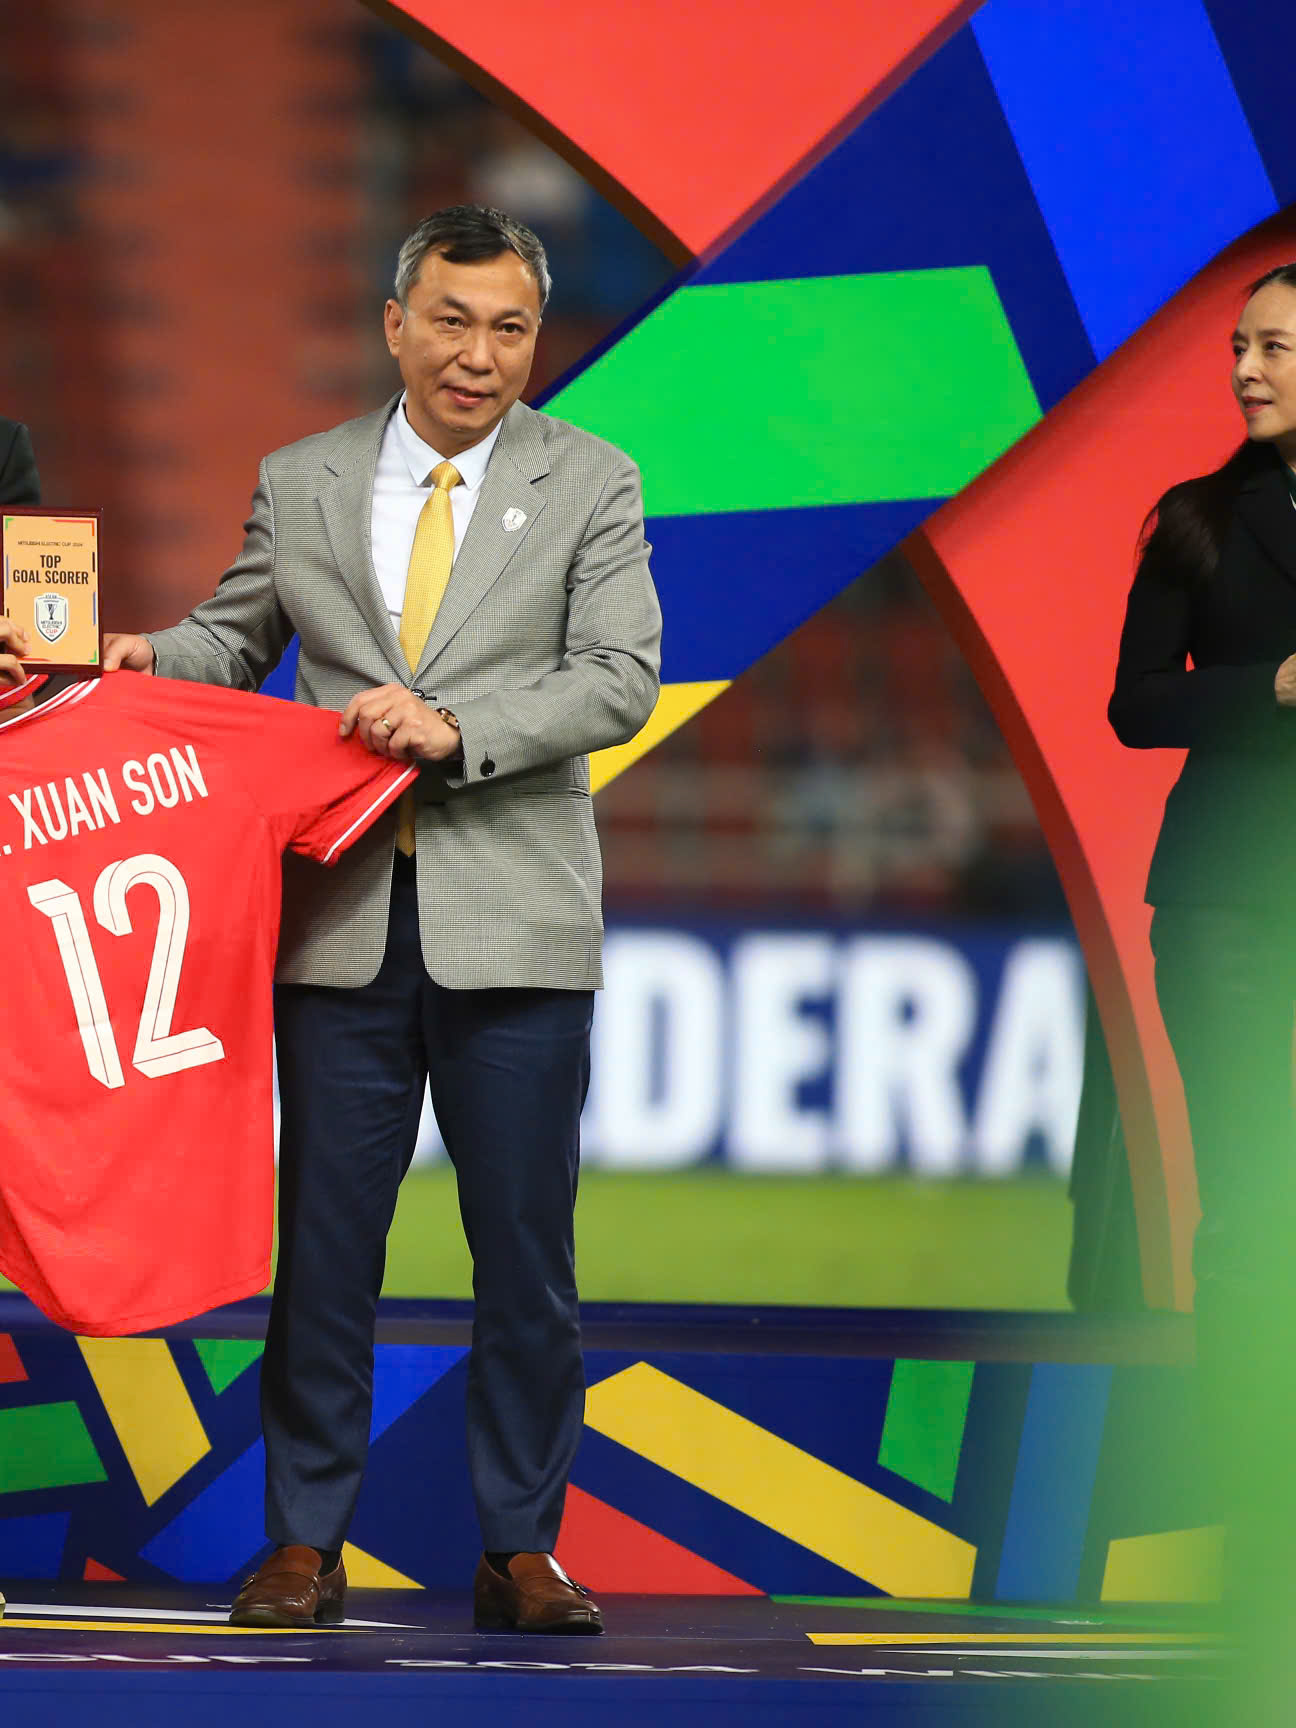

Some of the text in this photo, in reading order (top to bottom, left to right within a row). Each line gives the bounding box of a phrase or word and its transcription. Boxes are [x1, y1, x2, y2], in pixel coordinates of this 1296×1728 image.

[13, 570, 89, 585] GOAL SCORER
[40, 555, 61, 568] TOP
[8, 768, 121, 850] XUAN
[122, 744, 208, 816] SON
[26, 853, 225, 1089] 12
